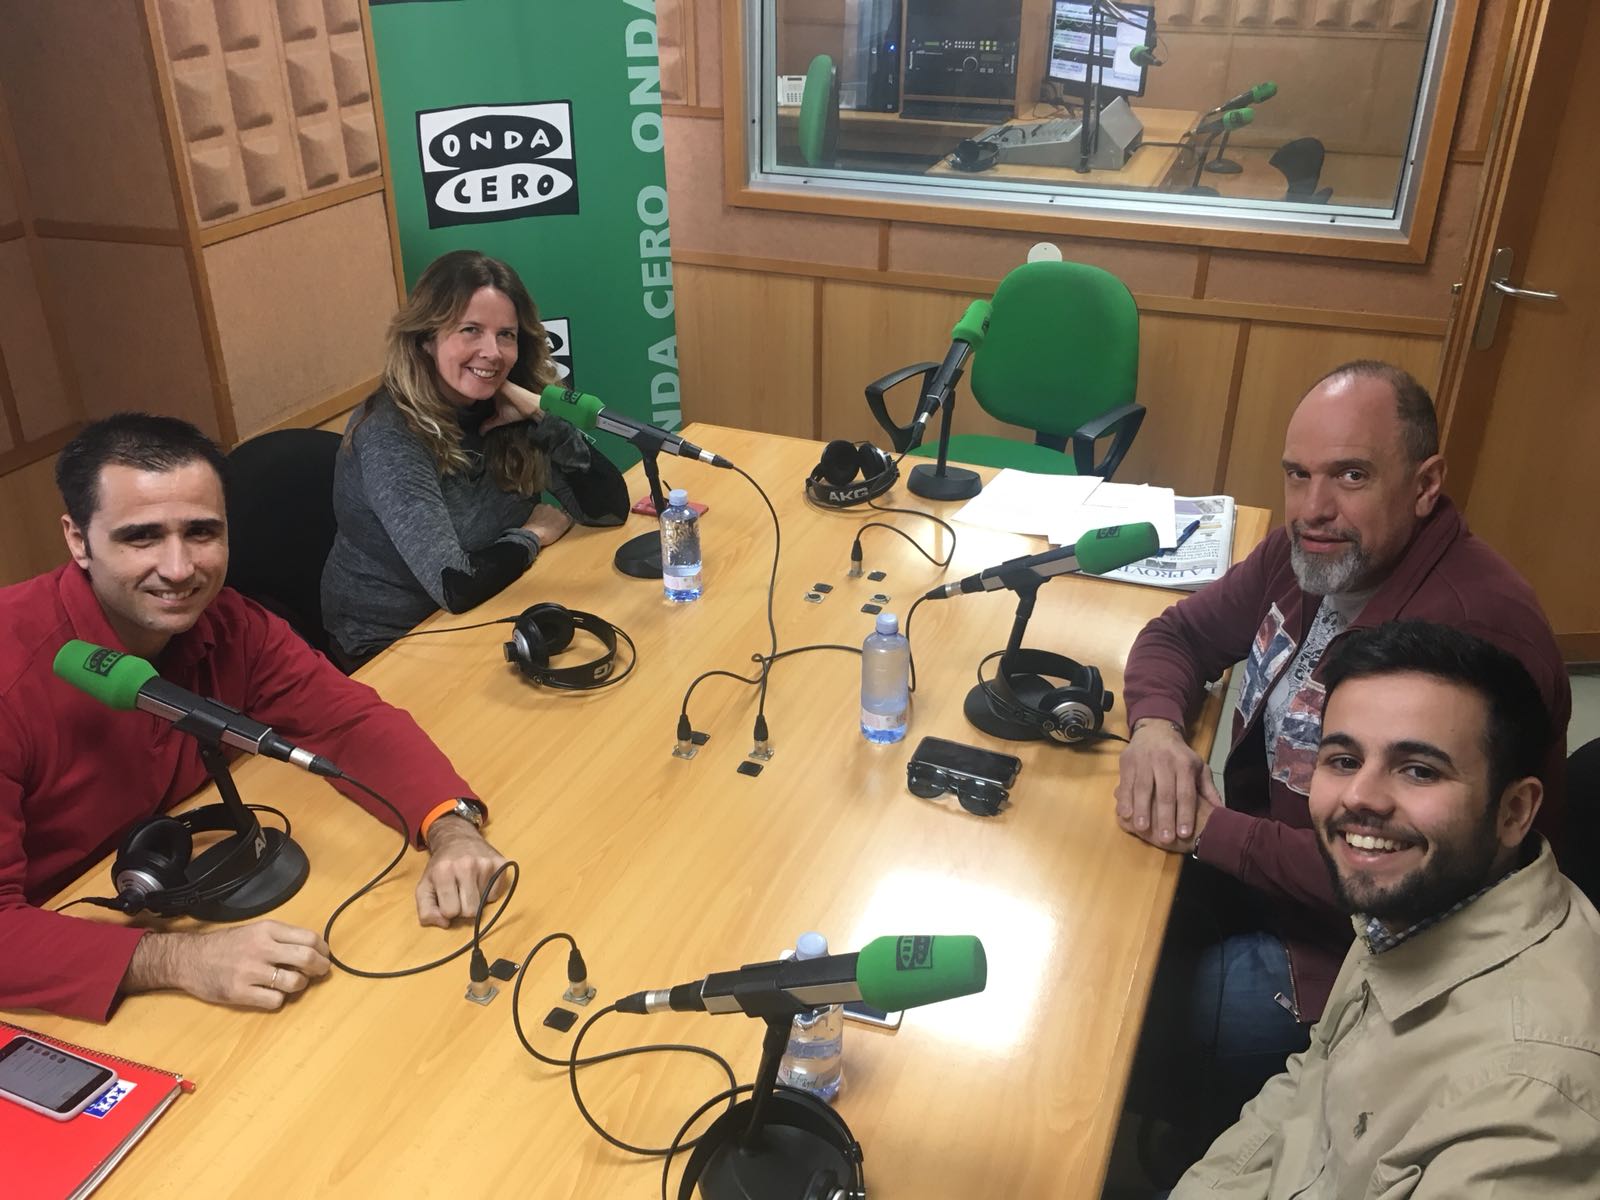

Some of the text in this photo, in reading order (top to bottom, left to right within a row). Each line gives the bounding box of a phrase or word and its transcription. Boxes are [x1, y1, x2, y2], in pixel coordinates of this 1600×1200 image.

[442, 128, 550, 157] ONDA
[454, 173, 554, 204] CERO
[637, 185, 675, 319] CERO
[829, 487, 869, 502] AKG
[1116, 565, 1185, 579] PROVI
